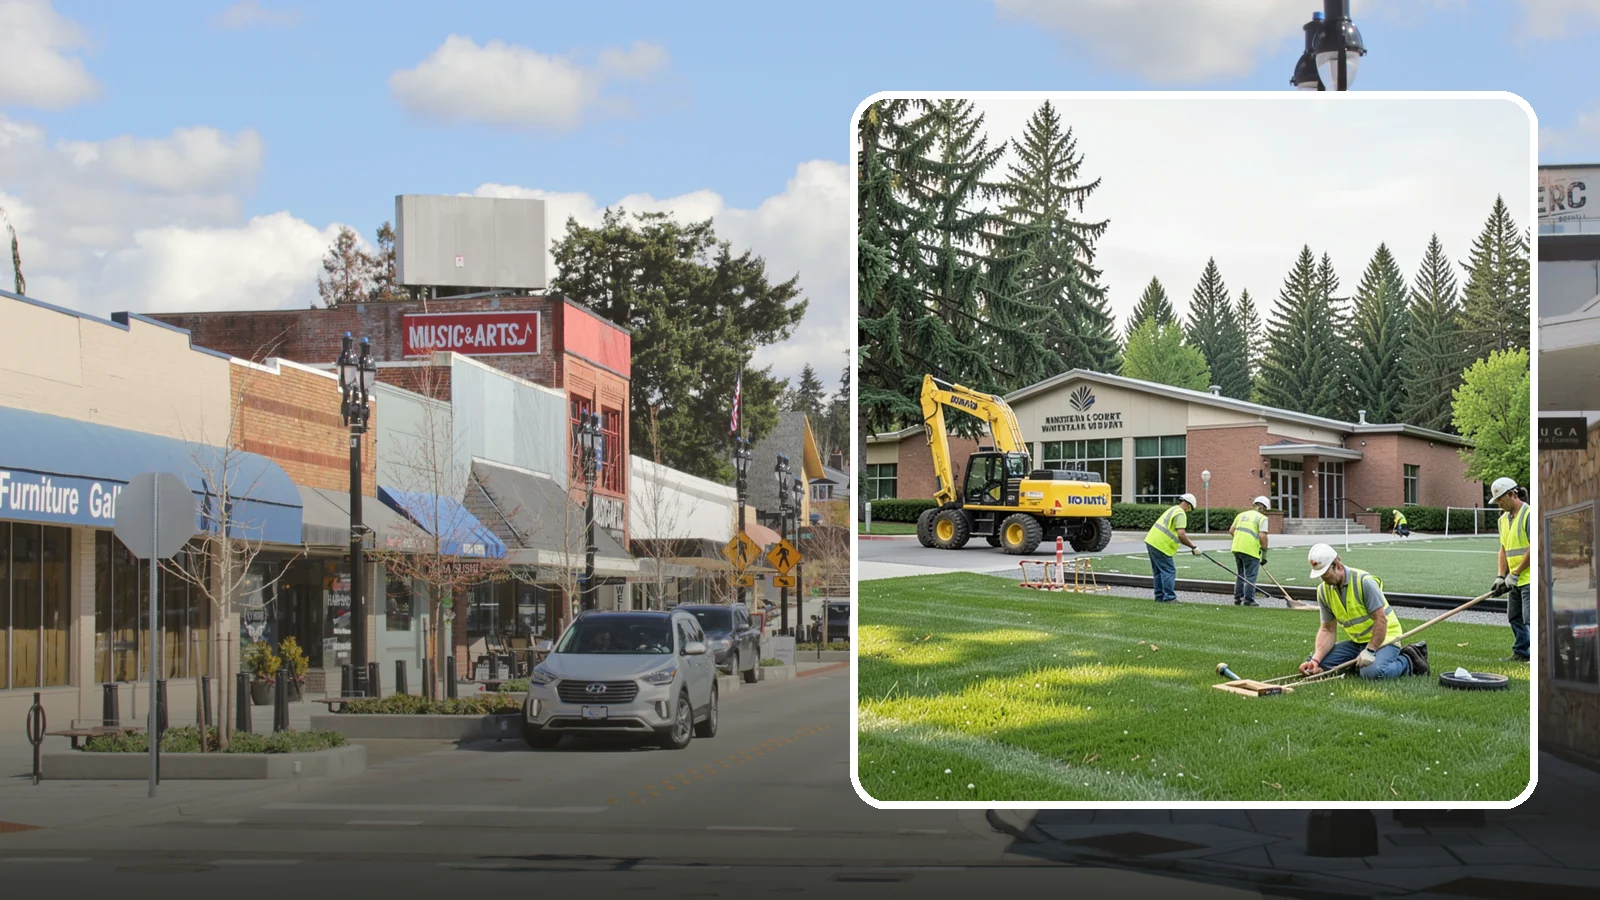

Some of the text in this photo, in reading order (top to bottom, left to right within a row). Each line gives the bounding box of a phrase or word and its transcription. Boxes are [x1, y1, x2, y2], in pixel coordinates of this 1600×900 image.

[409, 322, 519, 348] MUSIC&ARTS
[0, 471, 121, 518] Furniture Gal
[453, 563, 479, 573] SUSHI
